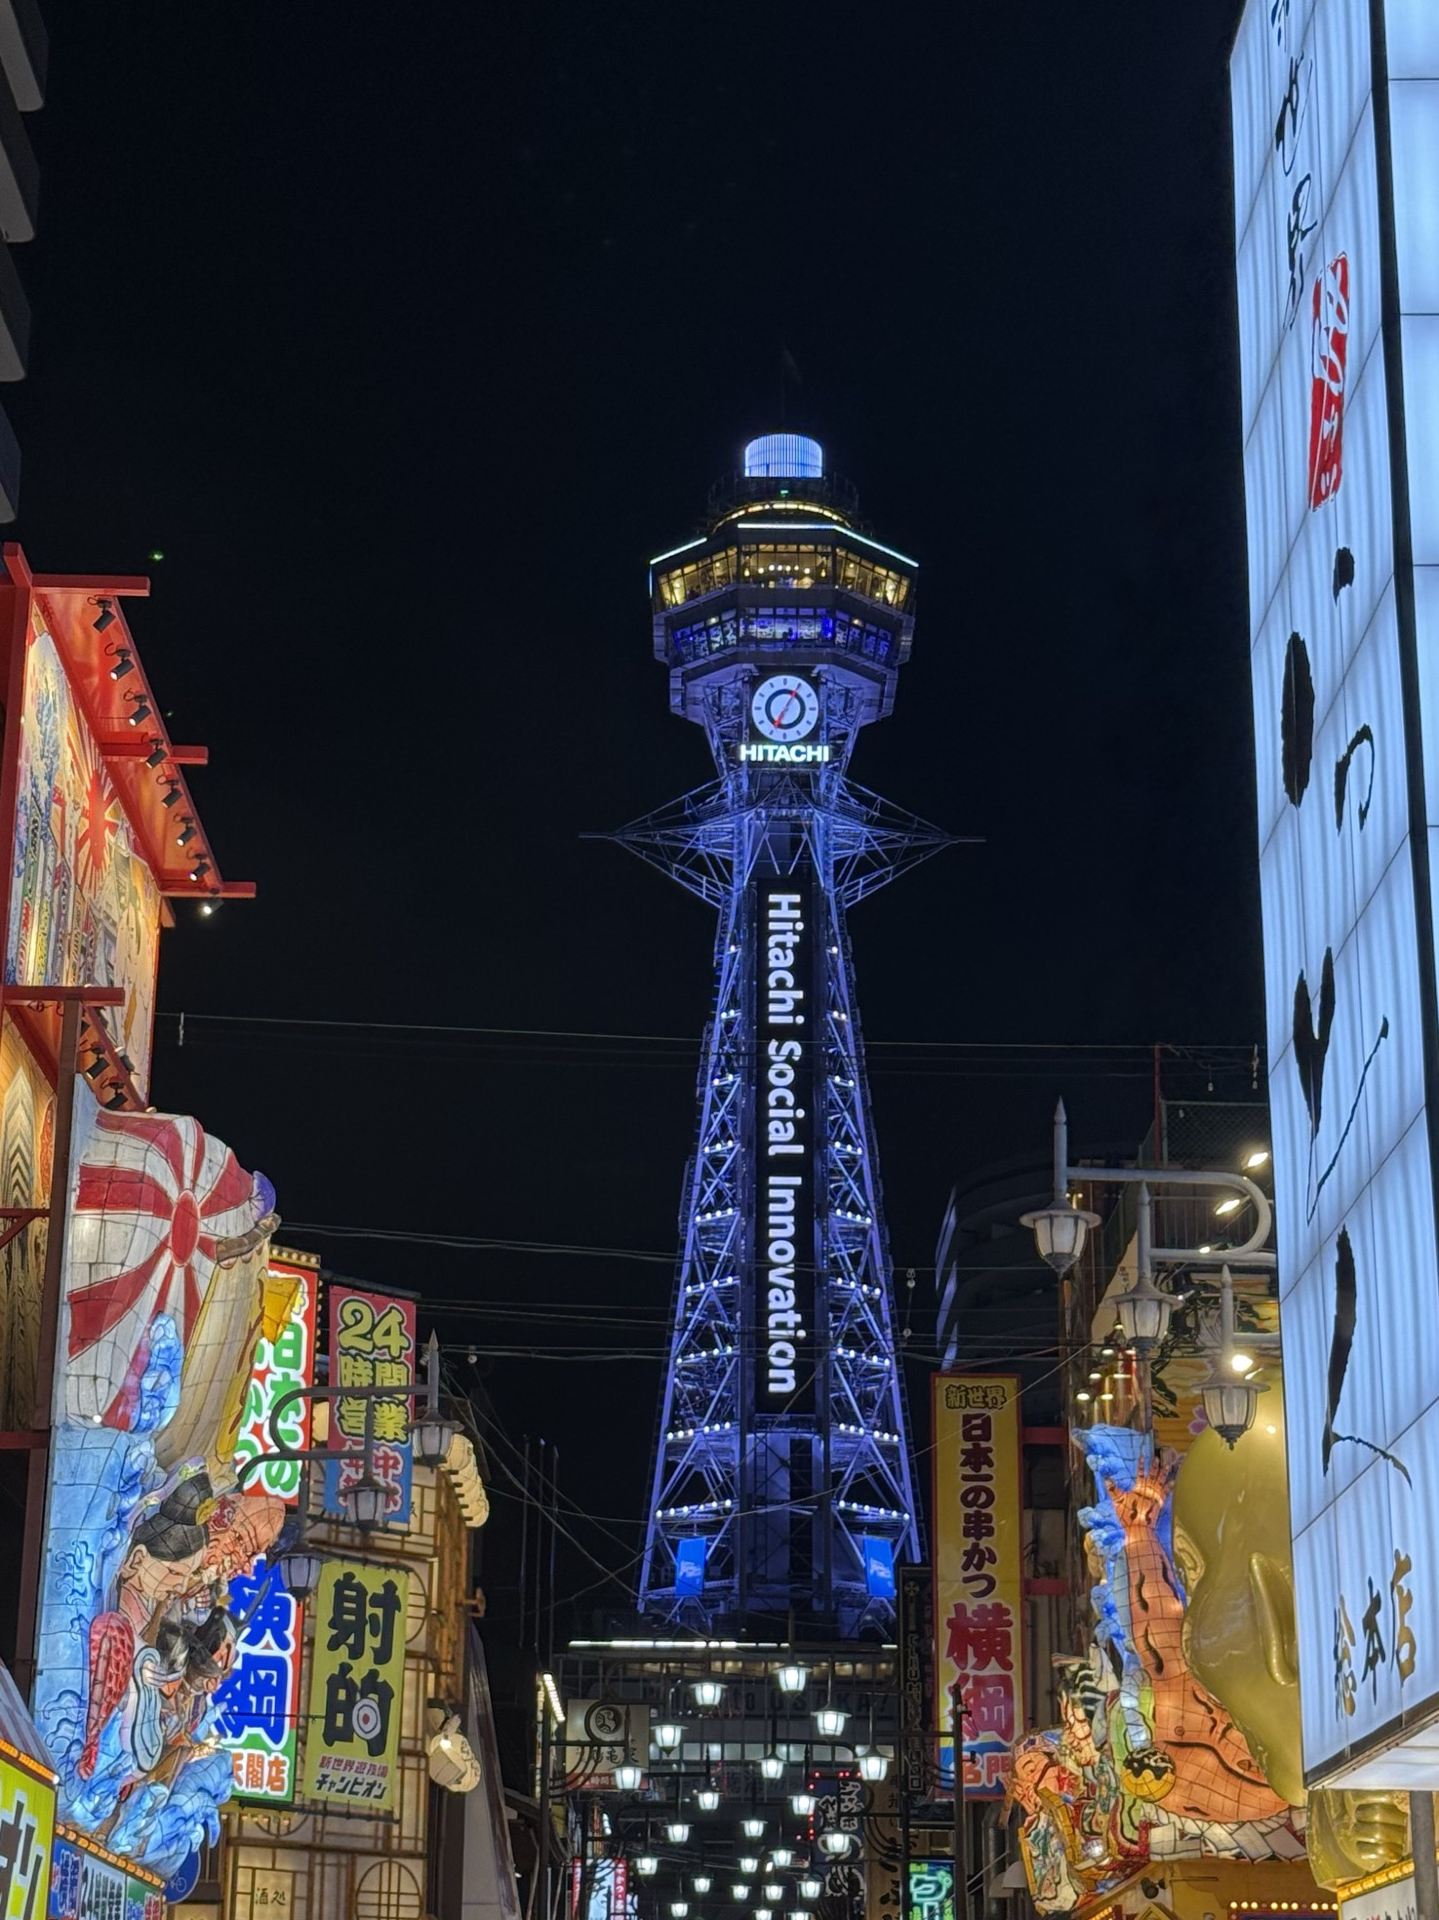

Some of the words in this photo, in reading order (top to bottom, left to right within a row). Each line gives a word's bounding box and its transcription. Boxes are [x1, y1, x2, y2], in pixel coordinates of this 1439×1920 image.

[740, 745, 830, 763] HITACHI
[767, 894, 804, 1025] Hitachi
[767, 1038, 805, 1156] Social
[767, 1176, 806, 1394] Innovation
[944, 1384, 1007, 1410] 新世界
[959, 1412, 998, 1600] 日本一の串かつ
[322, 1571, 402, 1758] 射的
[945, 1602, 1014, 1745] 横綱
[1333, 1548, 1416, 1721] 総本店
[316, 1773, 388, 1800] チャンピオン
